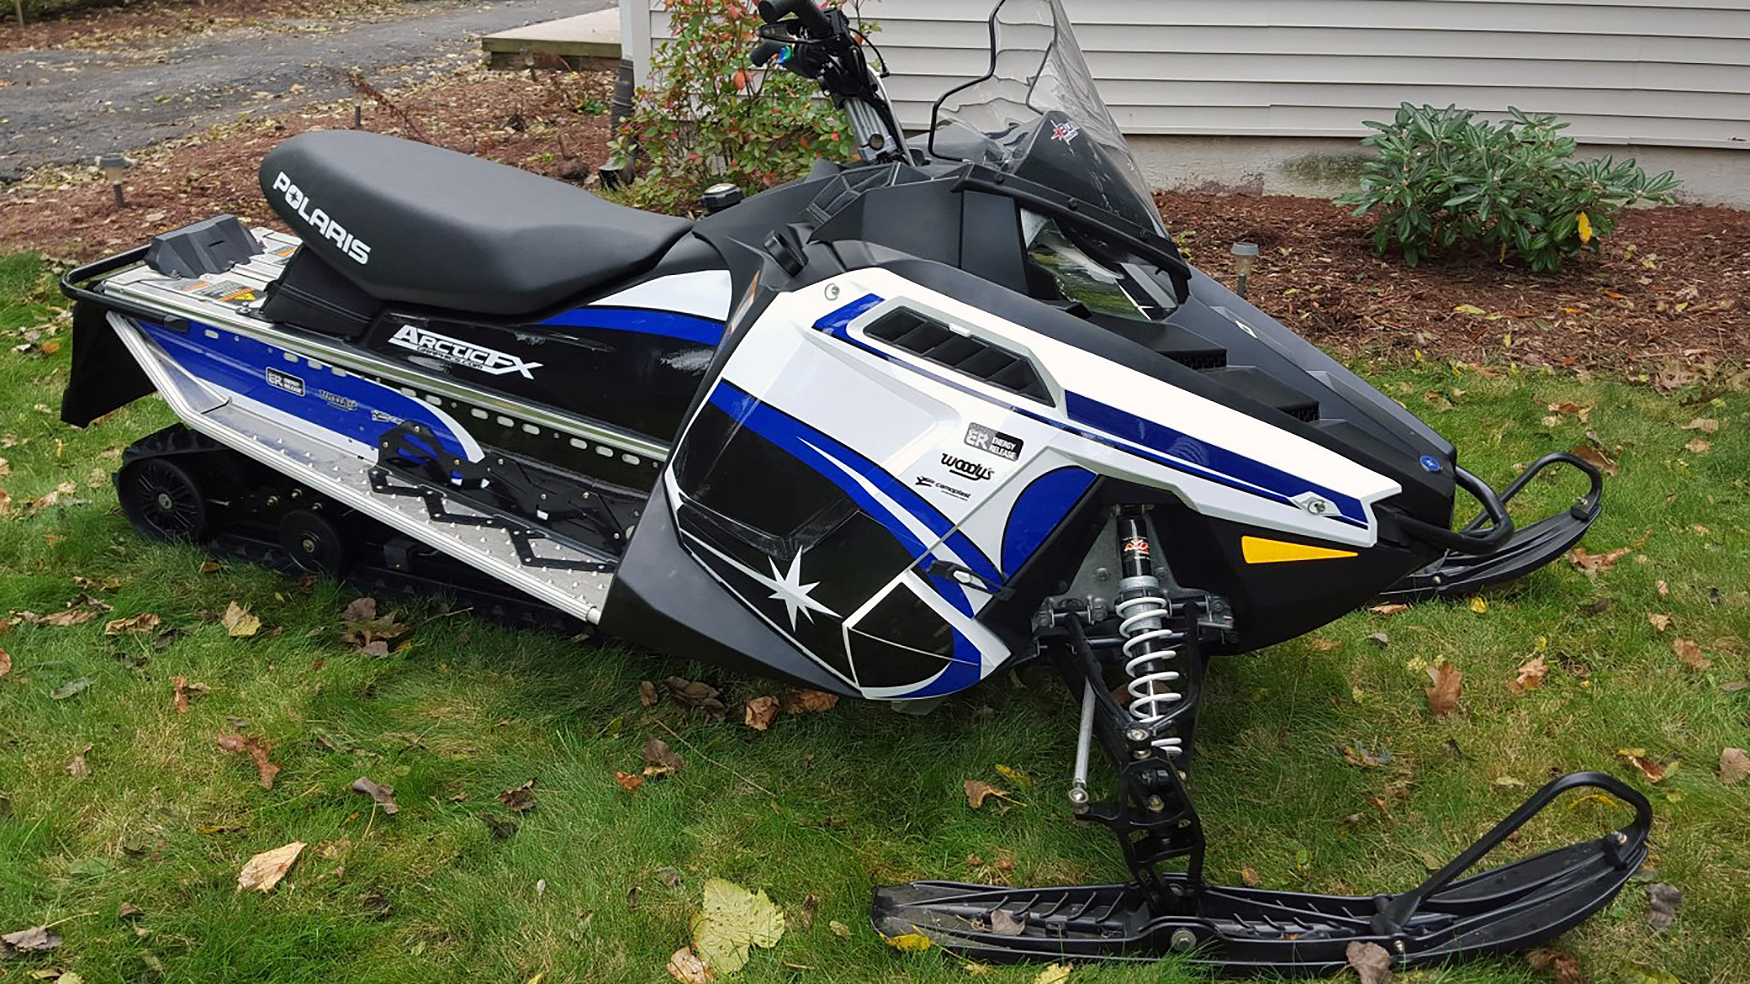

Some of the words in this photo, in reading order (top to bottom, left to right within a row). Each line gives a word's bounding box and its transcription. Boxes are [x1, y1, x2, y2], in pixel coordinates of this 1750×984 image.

[273, 171, 371, 265] POLARIS
[966, 429, 988, 450] ER
[991, 437, 1016, 451] ENERGY
[988, 445, 1018, 459] RELEASE
